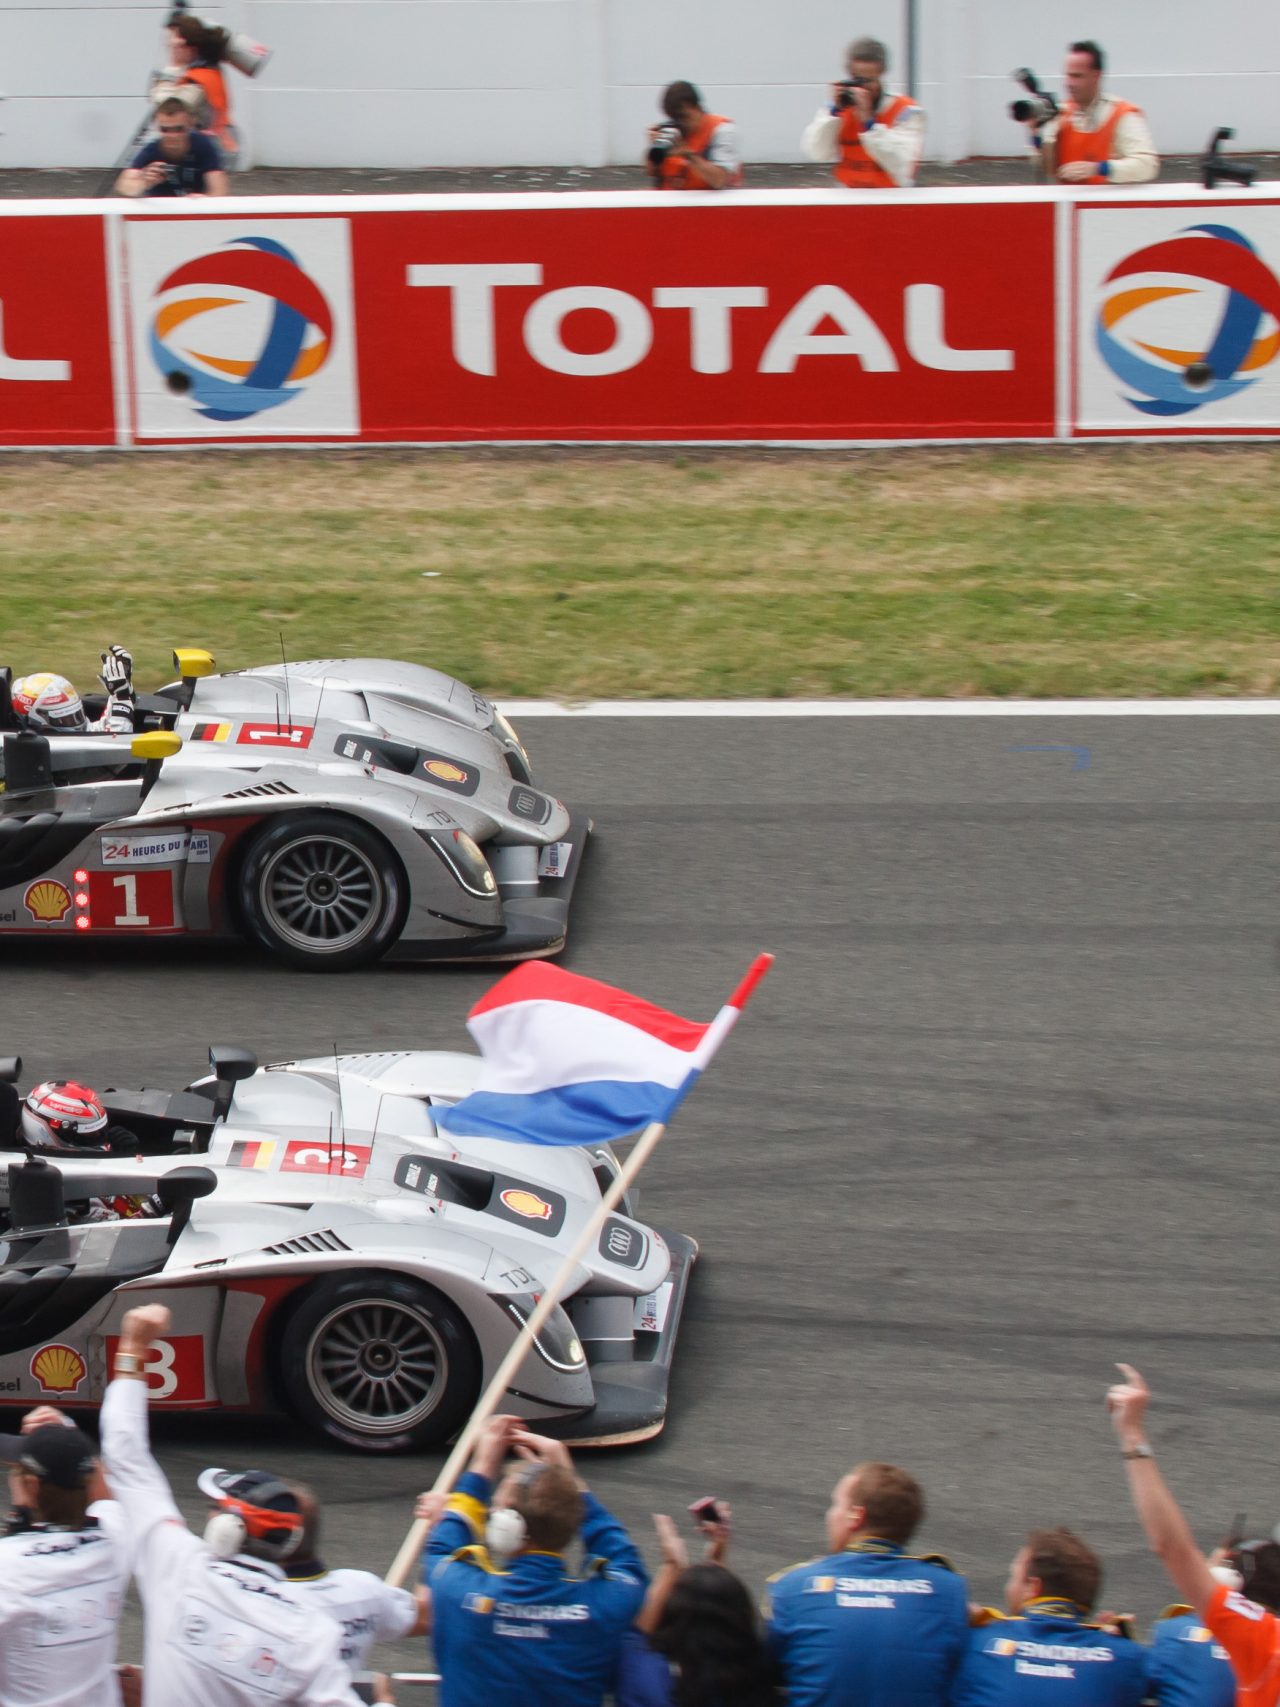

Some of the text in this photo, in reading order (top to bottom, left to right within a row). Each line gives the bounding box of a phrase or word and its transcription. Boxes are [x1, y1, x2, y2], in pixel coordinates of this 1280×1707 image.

[406, 263, 1015, 377] TOTAL
[103, 844, 130, 860] 24
[132, 843, 166, 857] HEURES
[168, 841, 181, 851] DU
[113, 874, 150, 926] 1
[143, 1339, 178, 1399] 3
